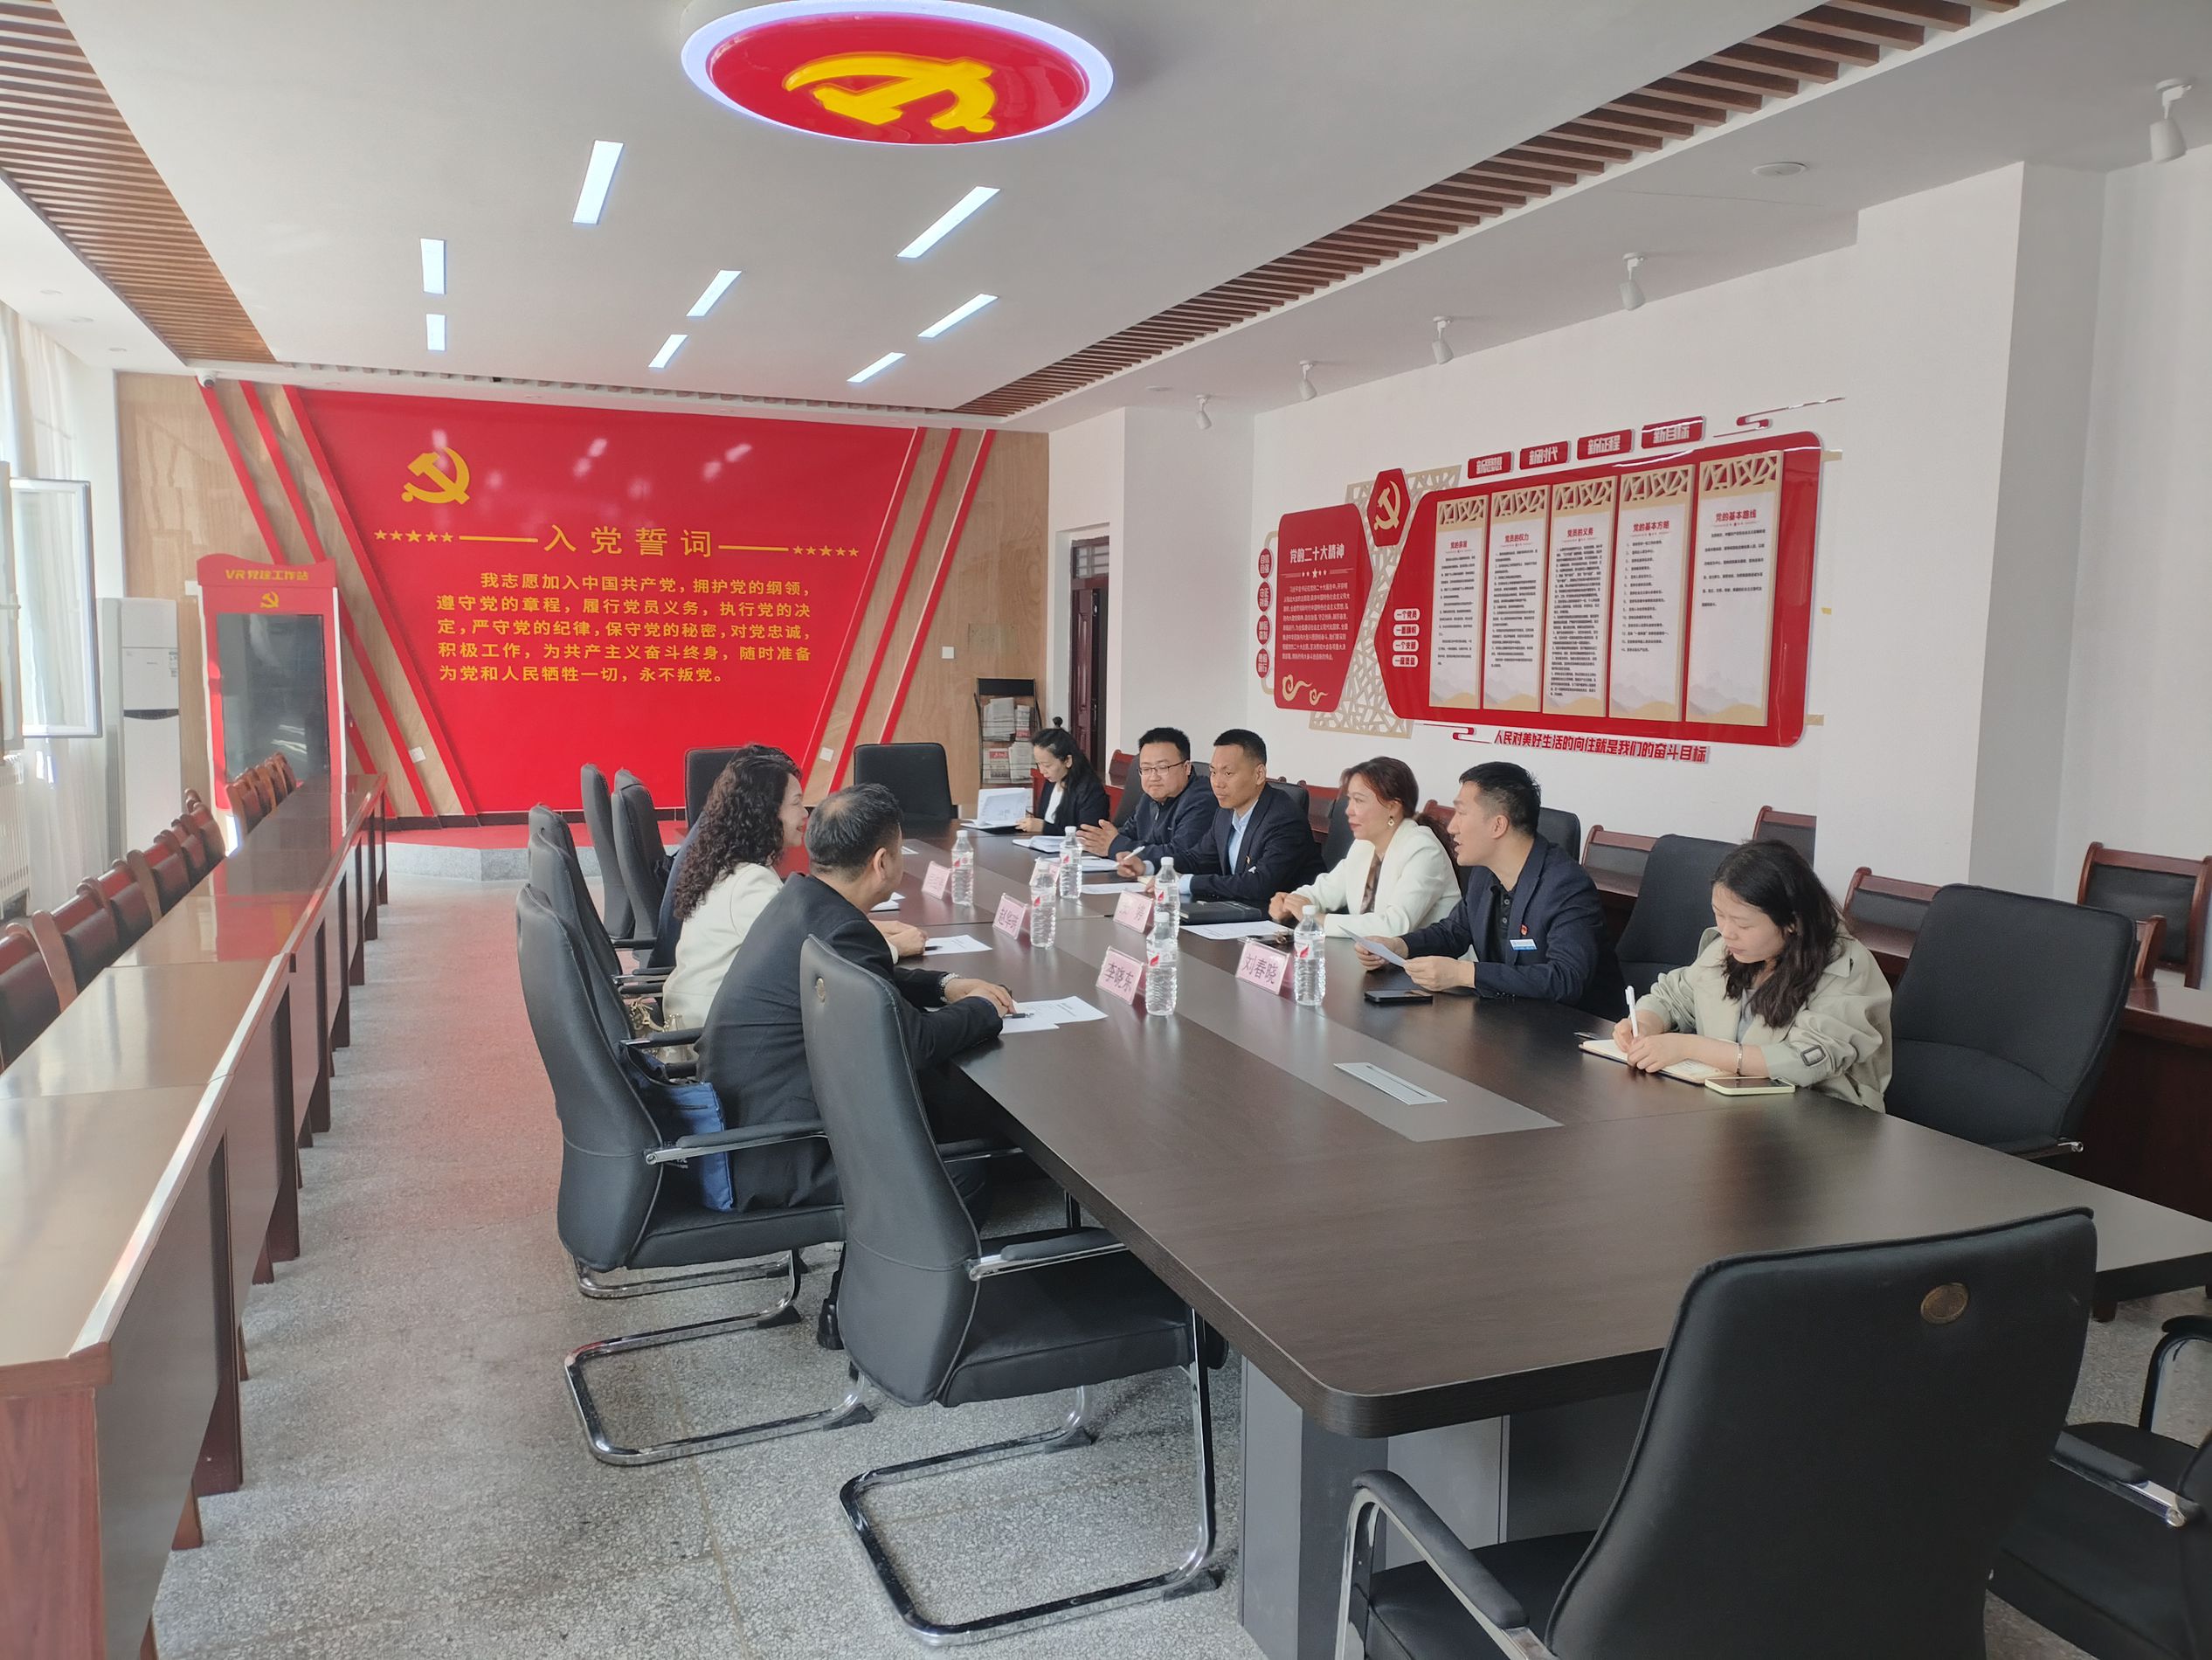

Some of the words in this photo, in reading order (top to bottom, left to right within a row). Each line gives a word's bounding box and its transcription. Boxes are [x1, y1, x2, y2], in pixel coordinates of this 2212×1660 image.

[1529, 446, 1559, 465] 新时代
[544, 524, 712, 558] 入党誓词
[1289, 543, 1345, 564] 党的二十大精神
[1494, 730, 1707, 763] 人民对美好生活的向往就是我们的奋斗目标
[1103, 962, 1134, 993] 李晓东
[1241, 953, 1279, 985] 刘春晓
